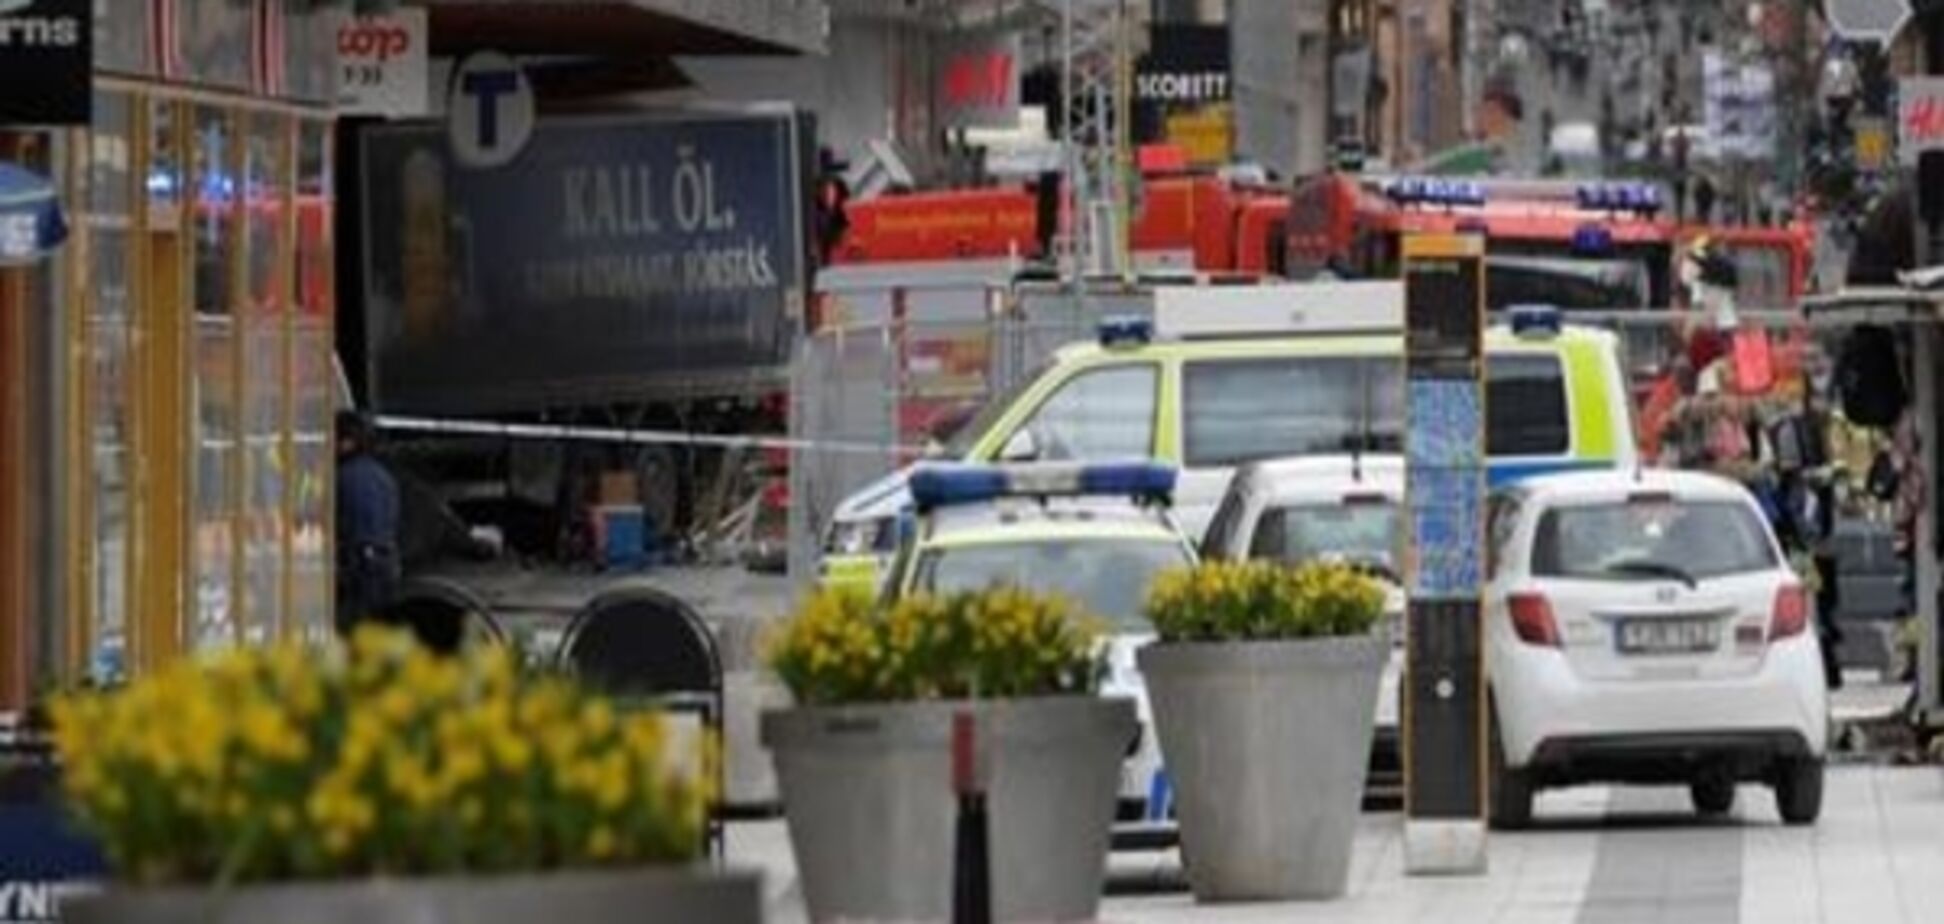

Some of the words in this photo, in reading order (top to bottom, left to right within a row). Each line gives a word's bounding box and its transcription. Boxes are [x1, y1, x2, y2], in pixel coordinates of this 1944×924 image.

[462, 70, 518, 149] T
[563, 164, 661, 237] KALL
[672, 145, 736, 232] ÖL.
